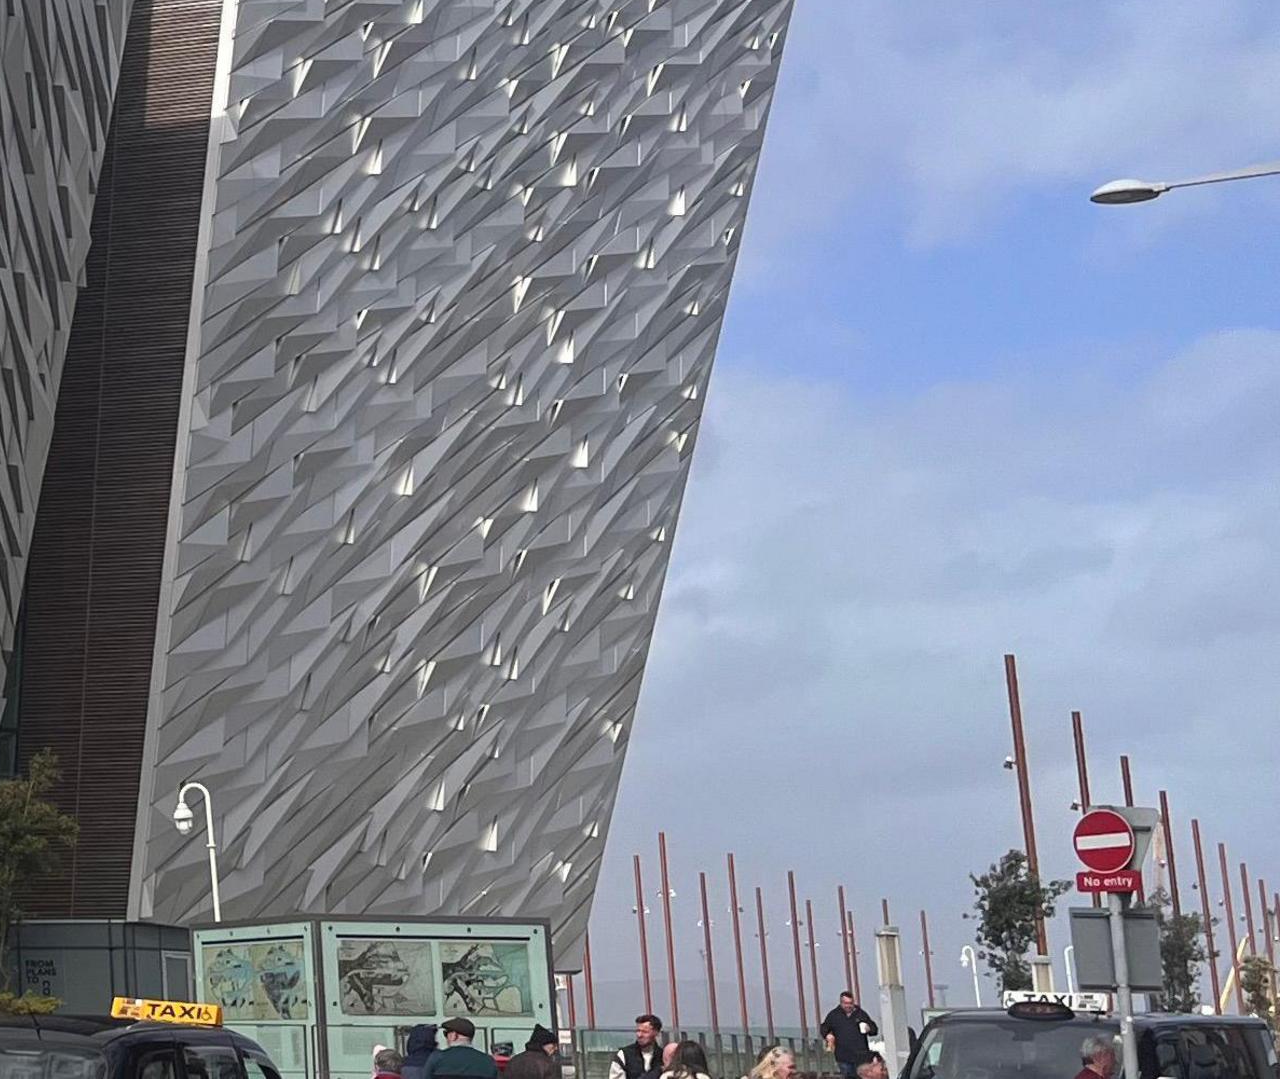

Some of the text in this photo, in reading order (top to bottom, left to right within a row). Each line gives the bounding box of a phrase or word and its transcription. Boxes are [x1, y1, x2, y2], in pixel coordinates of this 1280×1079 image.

[1083, 875, 1132, 888] No entry
[25, 960, 55, 968] FROM
[26, 968, 57, 976] PLANS
[27, 976, 39, 984] TO
[1024, 994, 1073, 1008] TAXI
[148, 1003, 202, 1020] TAXI
